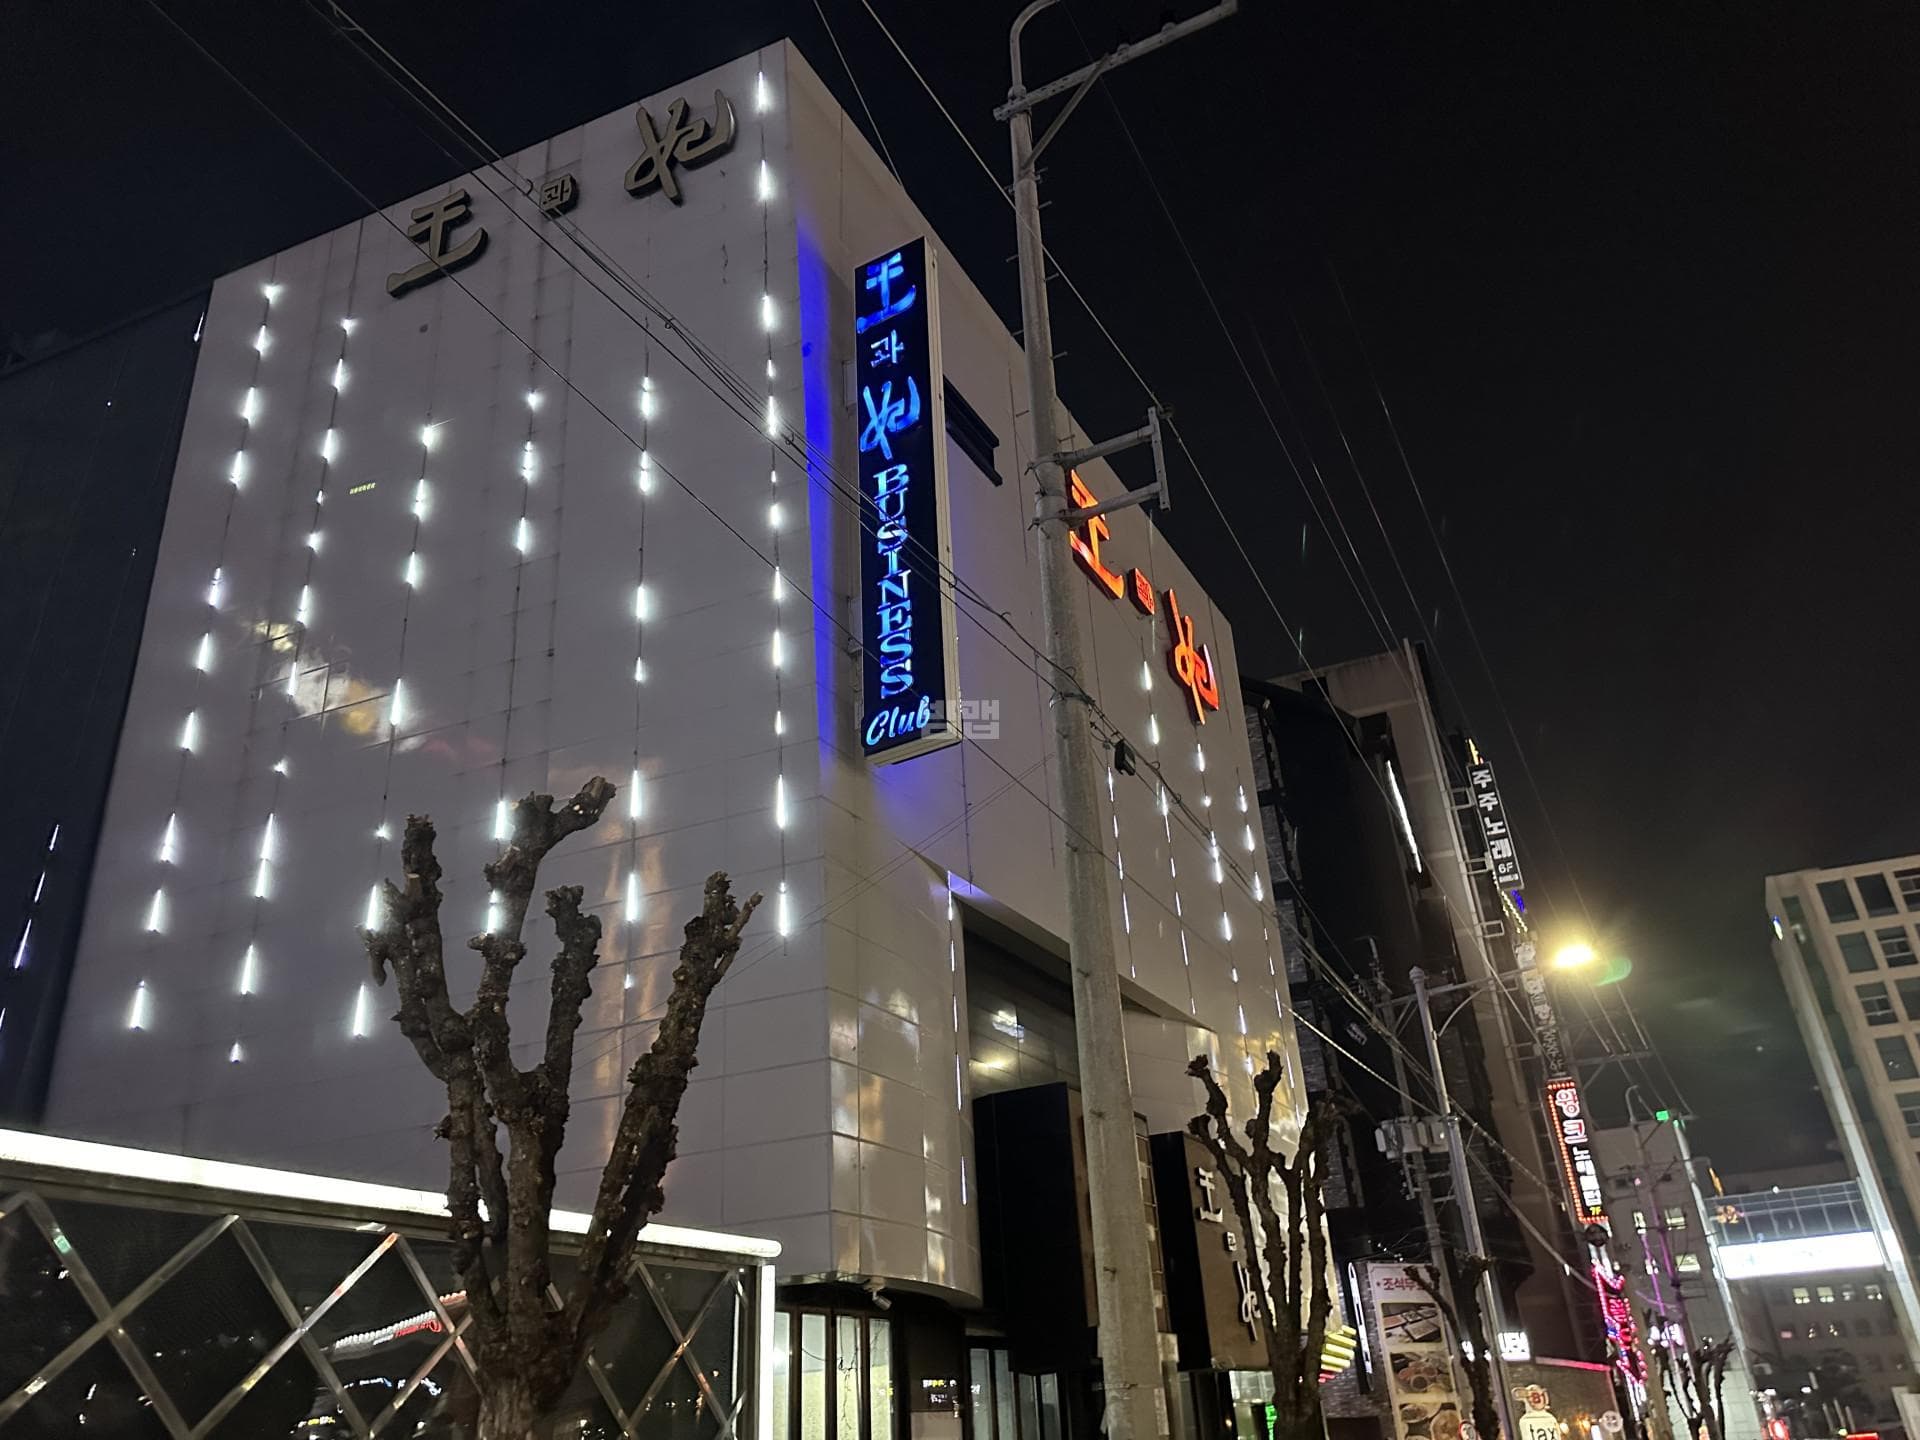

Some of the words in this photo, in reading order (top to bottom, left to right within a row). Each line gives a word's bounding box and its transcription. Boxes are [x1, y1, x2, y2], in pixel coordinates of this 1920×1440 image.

[873, 463, 914, 699] BUSINESS
[866, 695, 930, 746] Club
[1498, 862, 1514, 874] 6F
